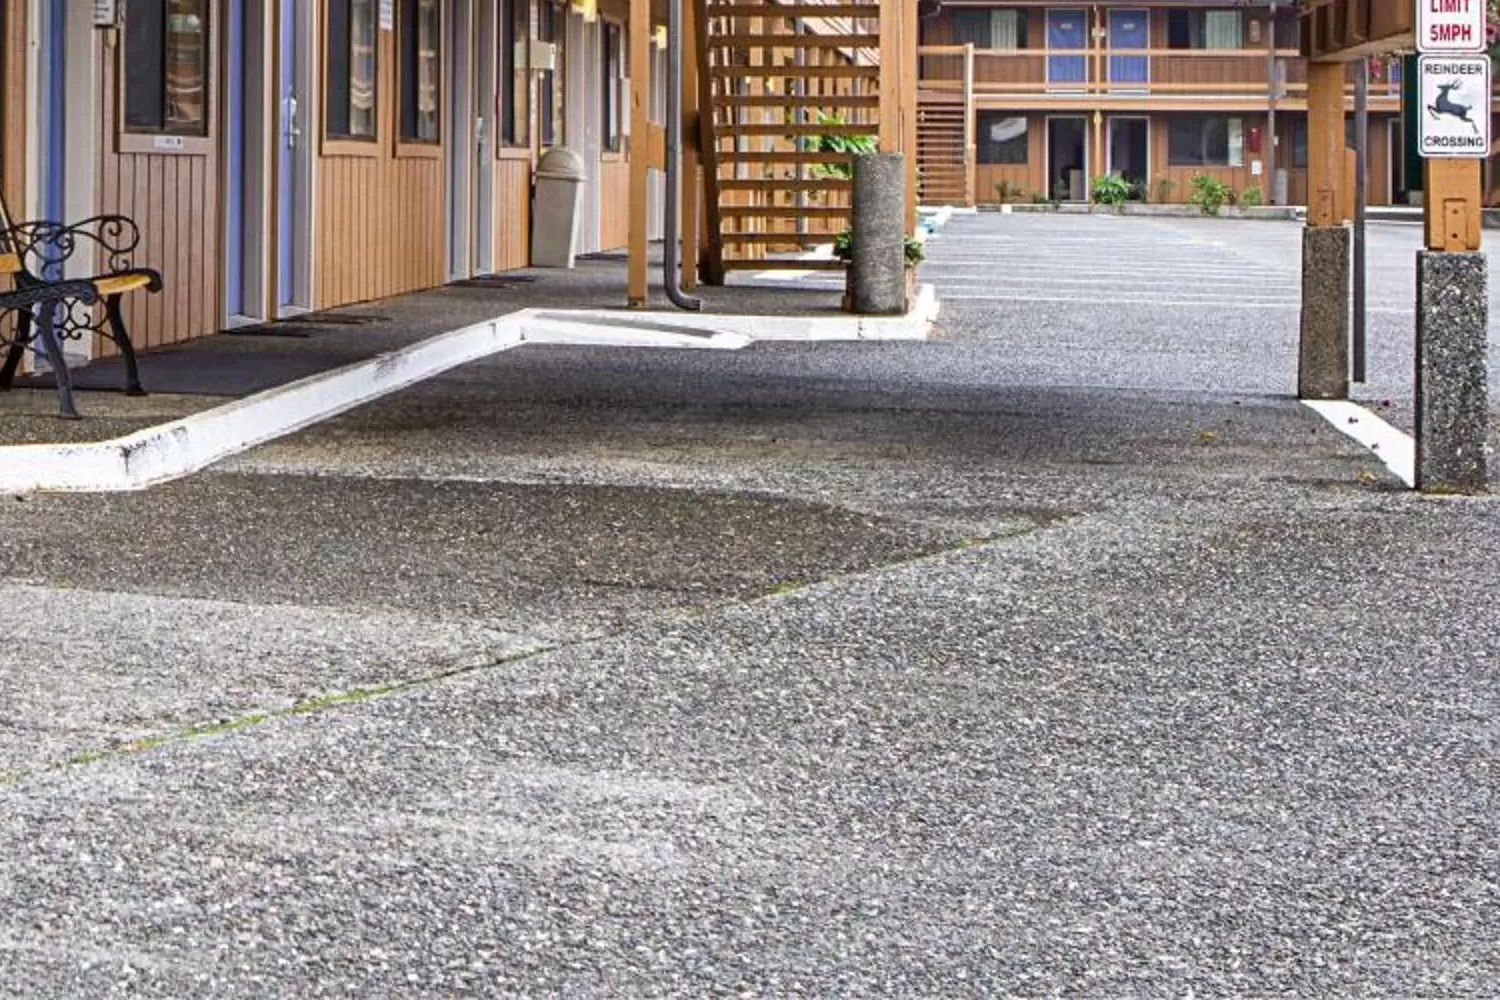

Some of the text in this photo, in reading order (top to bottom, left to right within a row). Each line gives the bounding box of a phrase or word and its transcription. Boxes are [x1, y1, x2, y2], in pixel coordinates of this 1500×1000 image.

[1429, 23, 1472, 42] 5MPH
[1424, 63, 1483, 75] REINDEER
[1424, 135, 1485, 147] CROSSING
